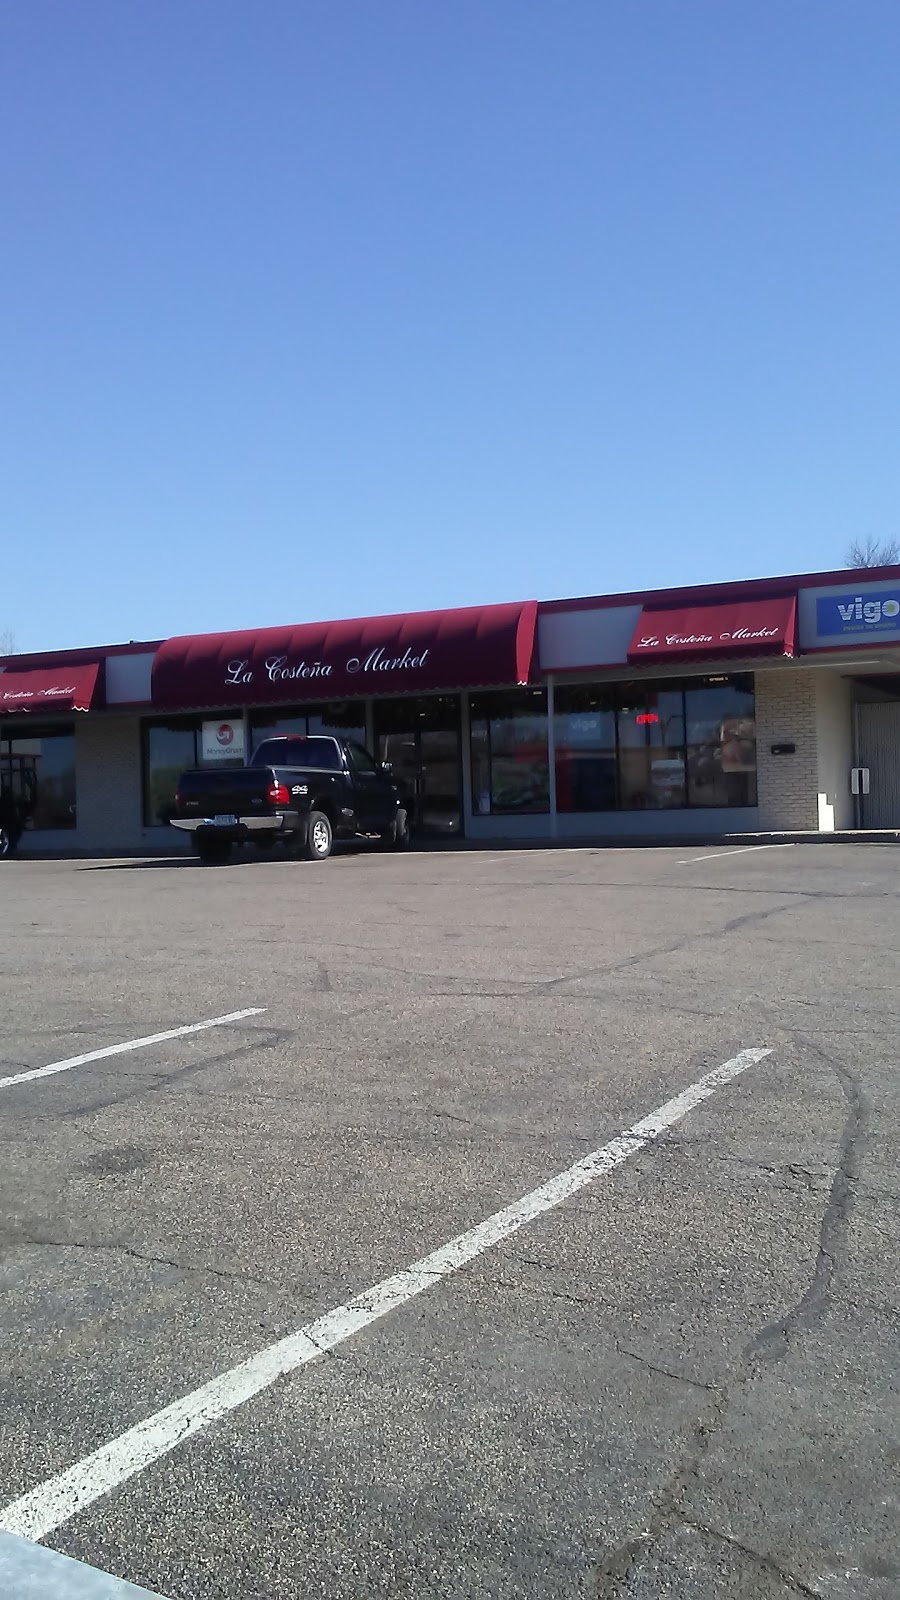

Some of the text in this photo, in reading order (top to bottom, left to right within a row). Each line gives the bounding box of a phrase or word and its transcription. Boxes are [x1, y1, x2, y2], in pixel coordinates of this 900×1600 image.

[837, 597, 900, 624] vigo
[637, 626, 779, 648] La Costeña Market
[224, 647, 429, 684] La Costeña Market
